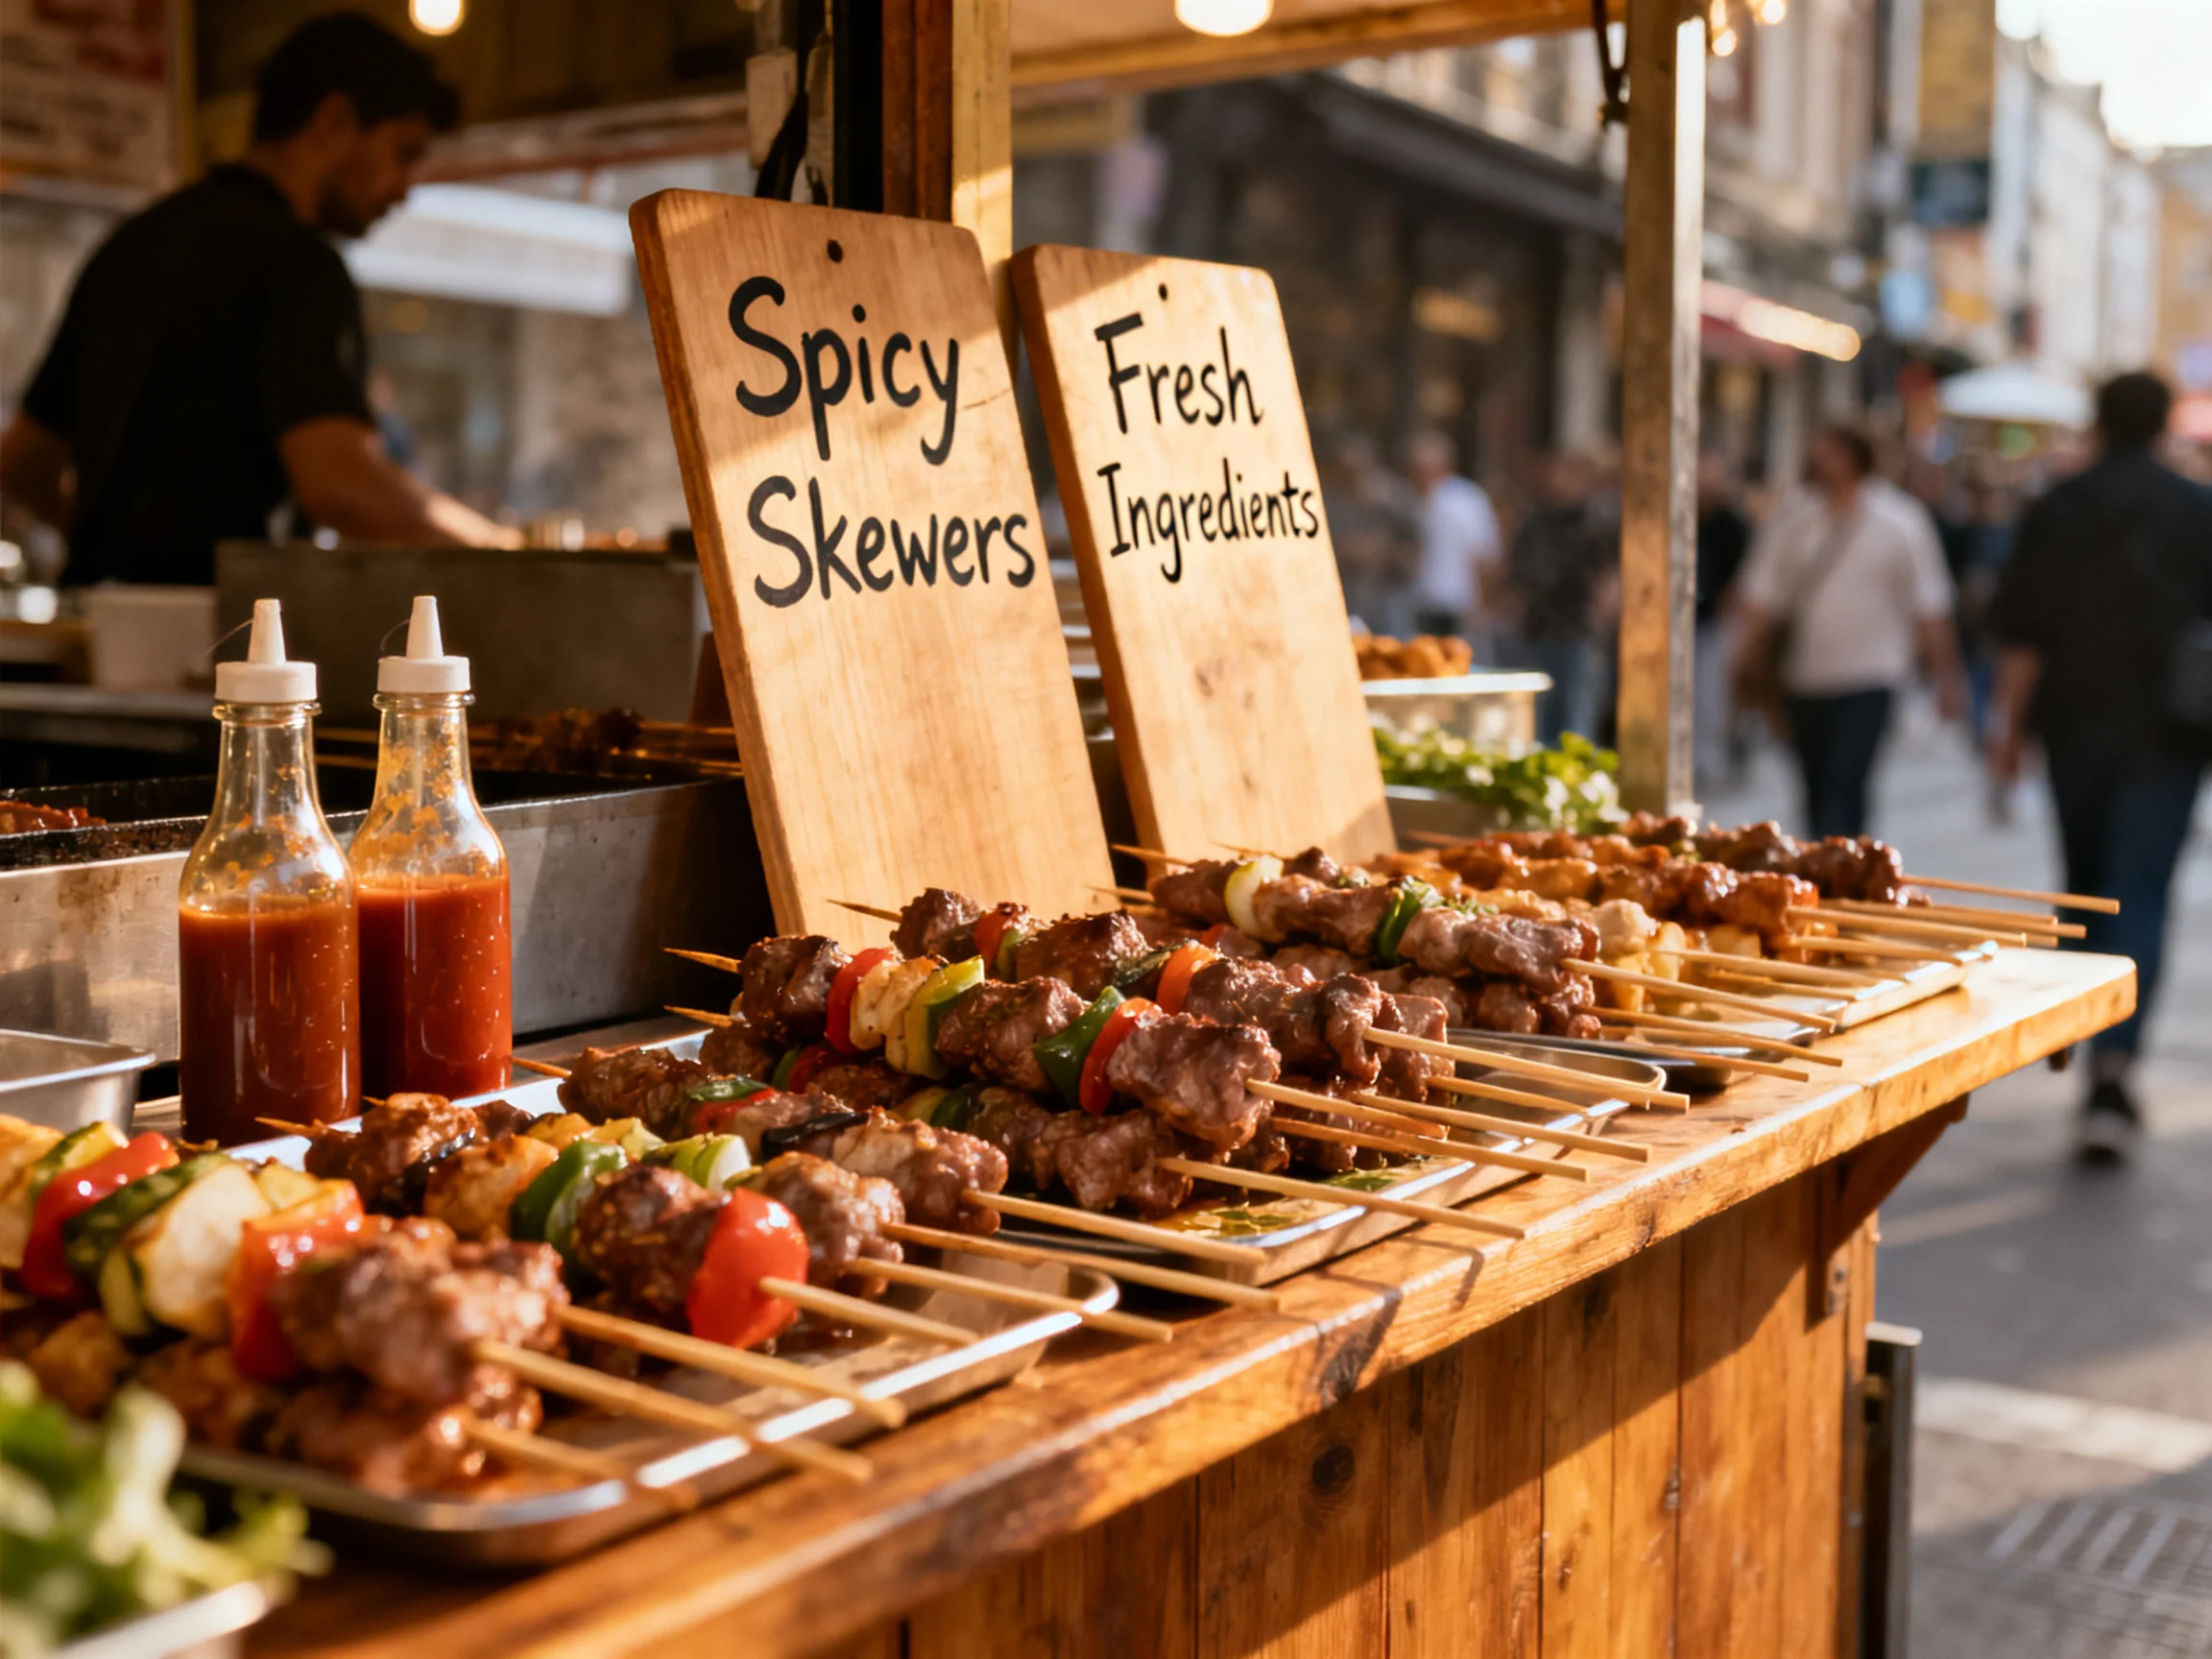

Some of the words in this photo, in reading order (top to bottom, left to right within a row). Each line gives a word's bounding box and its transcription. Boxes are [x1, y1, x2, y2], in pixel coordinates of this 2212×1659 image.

[729, 276, 959, 466] Spicy
[1094, 313, 1264, 434] Fresh
[747, 475, 1035, 608] Skewers
[1097, 458, 1319, 583] Ingredients
